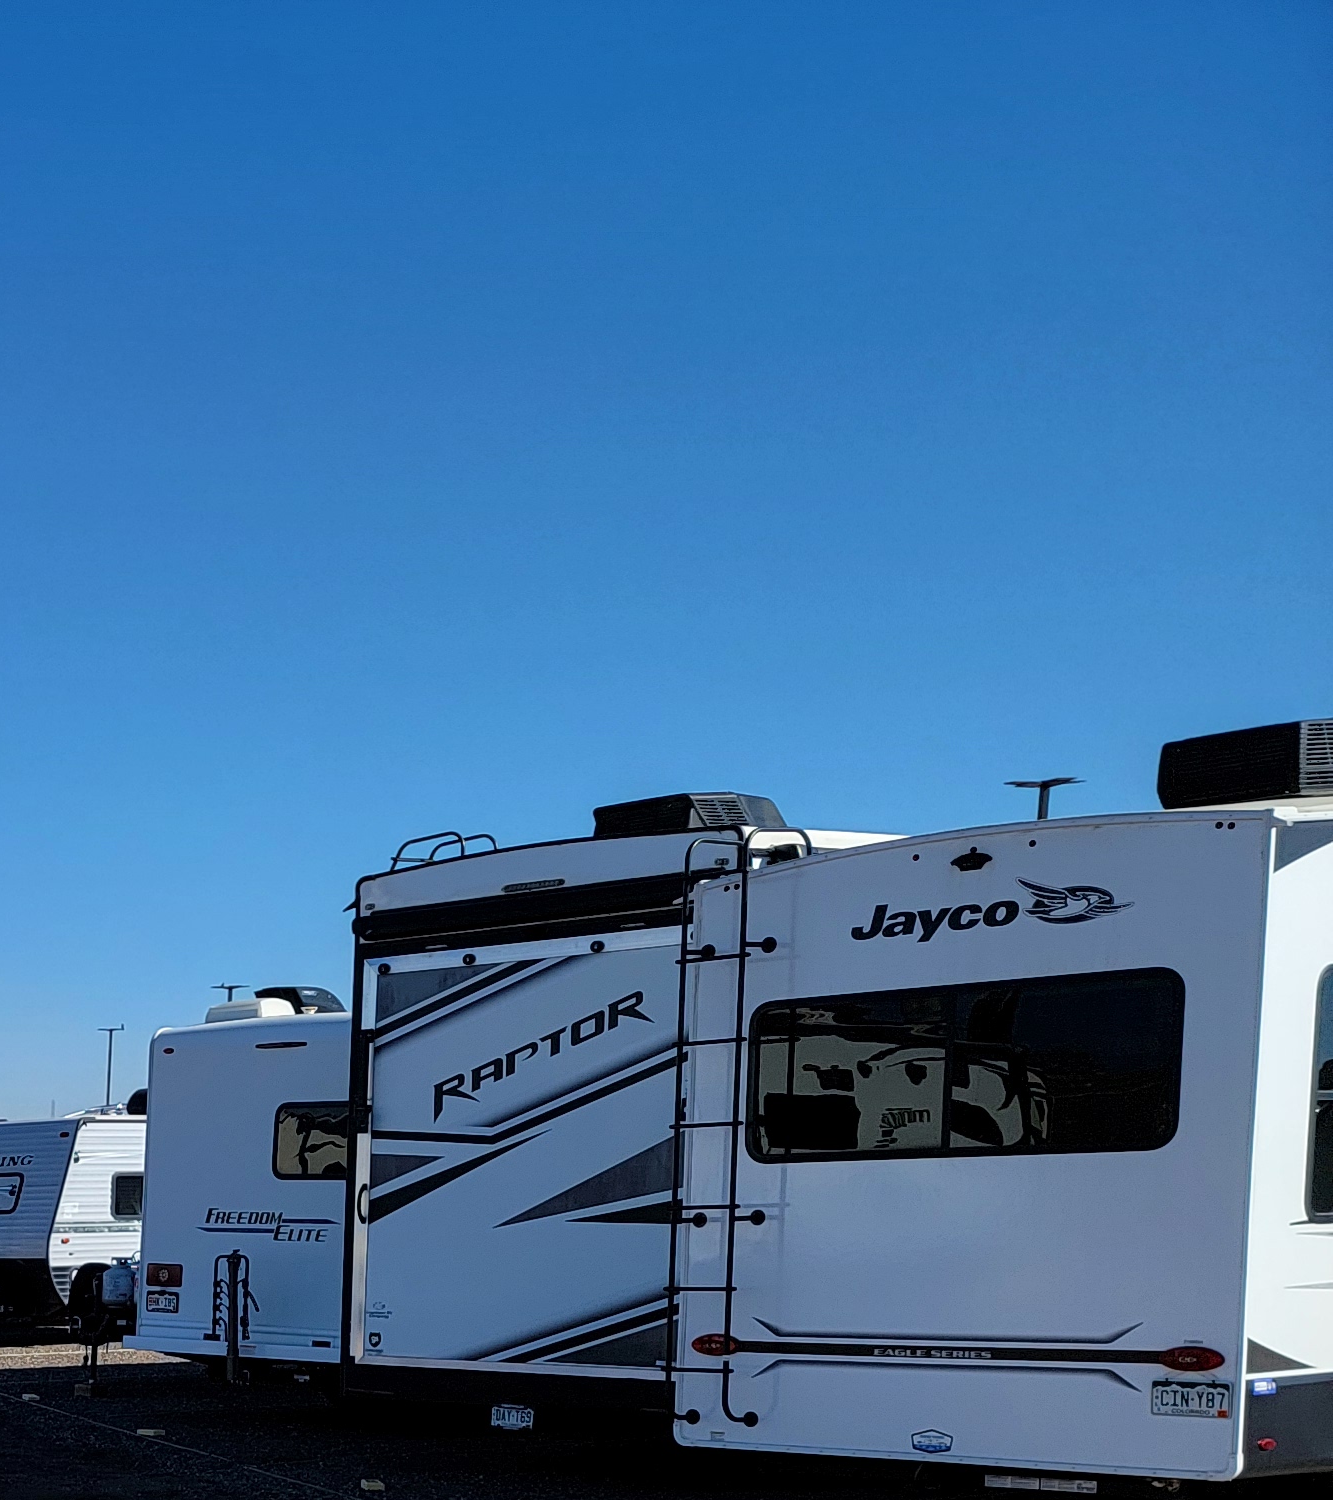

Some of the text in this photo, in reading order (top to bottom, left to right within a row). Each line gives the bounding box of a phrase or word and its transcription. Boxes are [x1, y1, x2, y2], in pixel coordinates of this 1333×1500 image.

[850, 900, 1020, 943] Jayco
[433, 990, 656, 1124] RAPTOR
[204, 1207, 284, 1225] FREEDOM
[272, 1224, 329, 1242] ELITE
[873, 1348, 992, 1359] EAGLE SERIES
